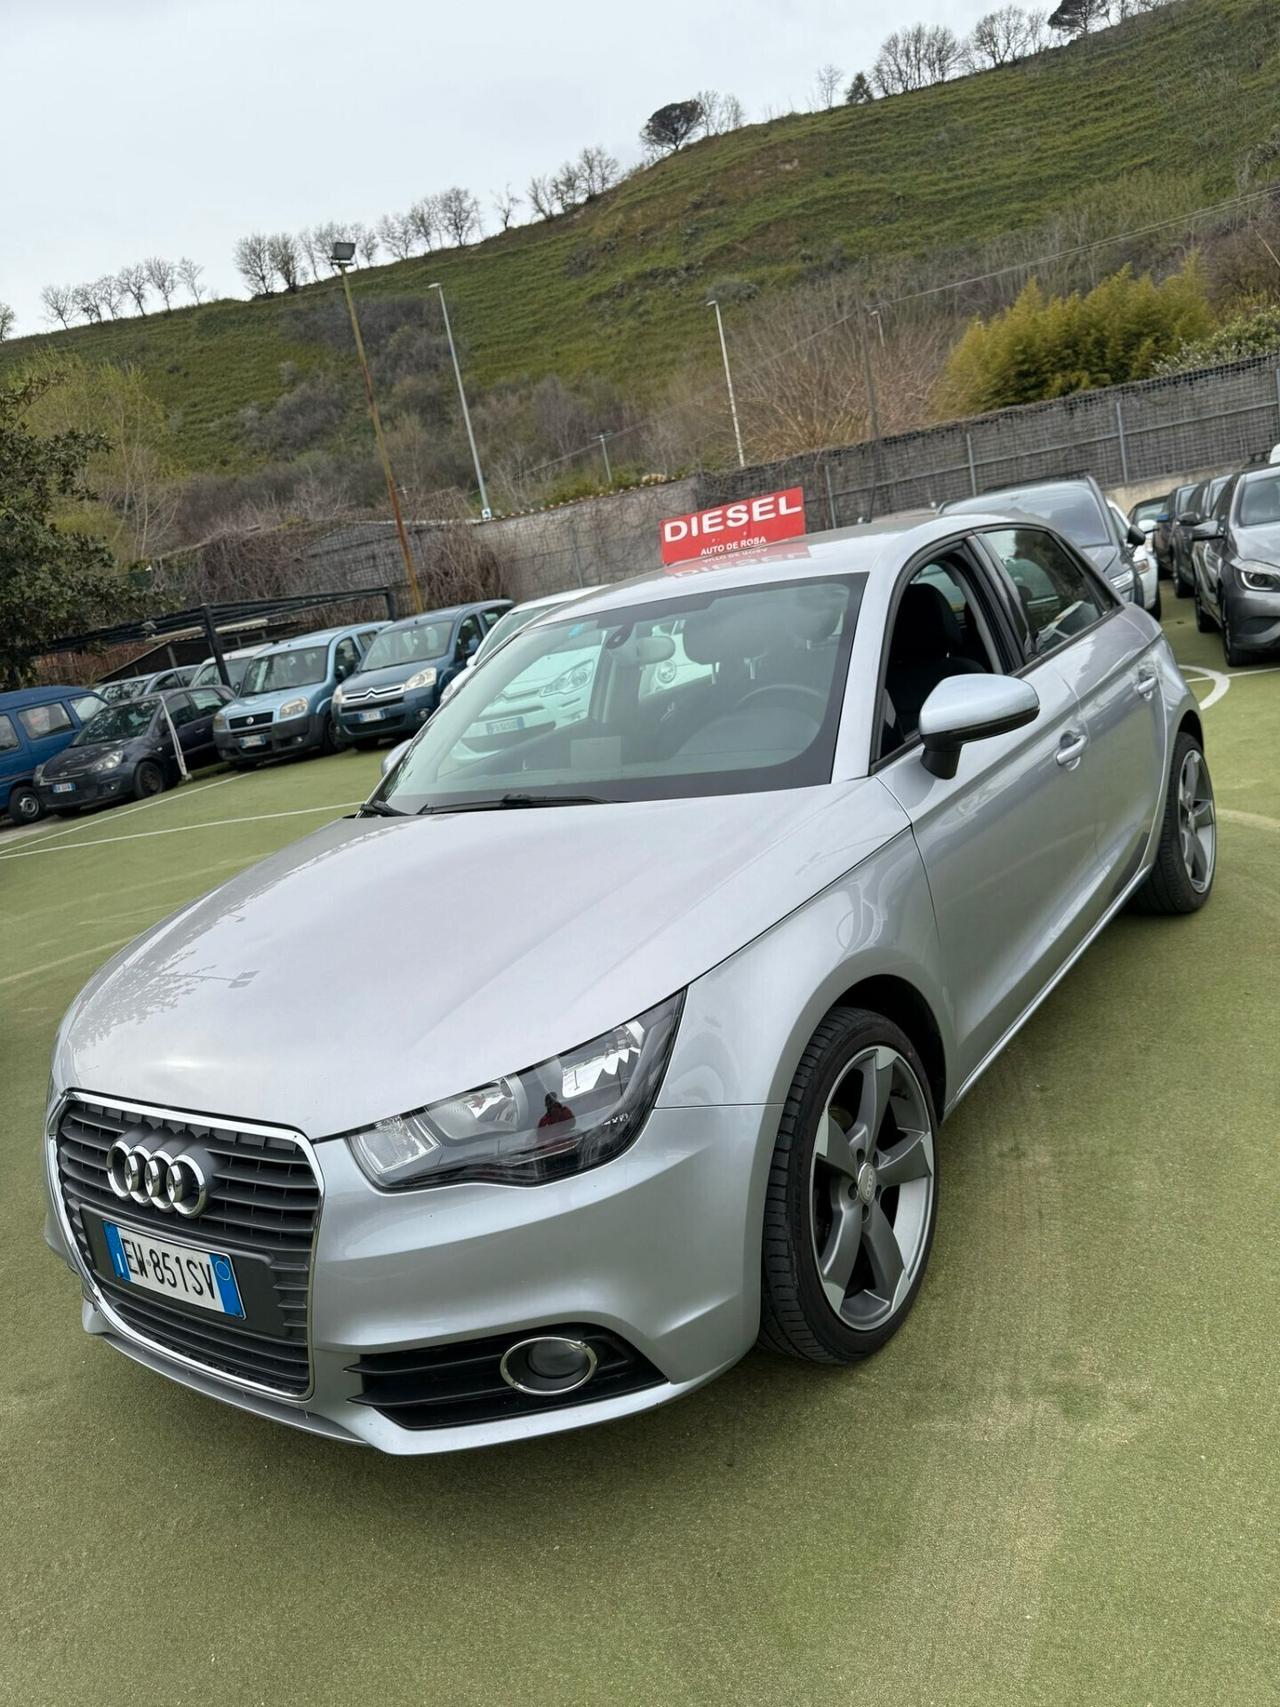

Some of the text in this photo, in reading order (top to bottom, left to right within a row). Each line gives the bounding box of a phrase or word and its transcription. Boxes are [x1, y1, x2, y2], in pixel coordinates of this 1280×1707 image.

[664, 496, 802, 542] DIESEL
[701, 543, 724, 556] AUTO
[726, 541, 738, 550] DE
[740, 536, 766, 548] ROSA
